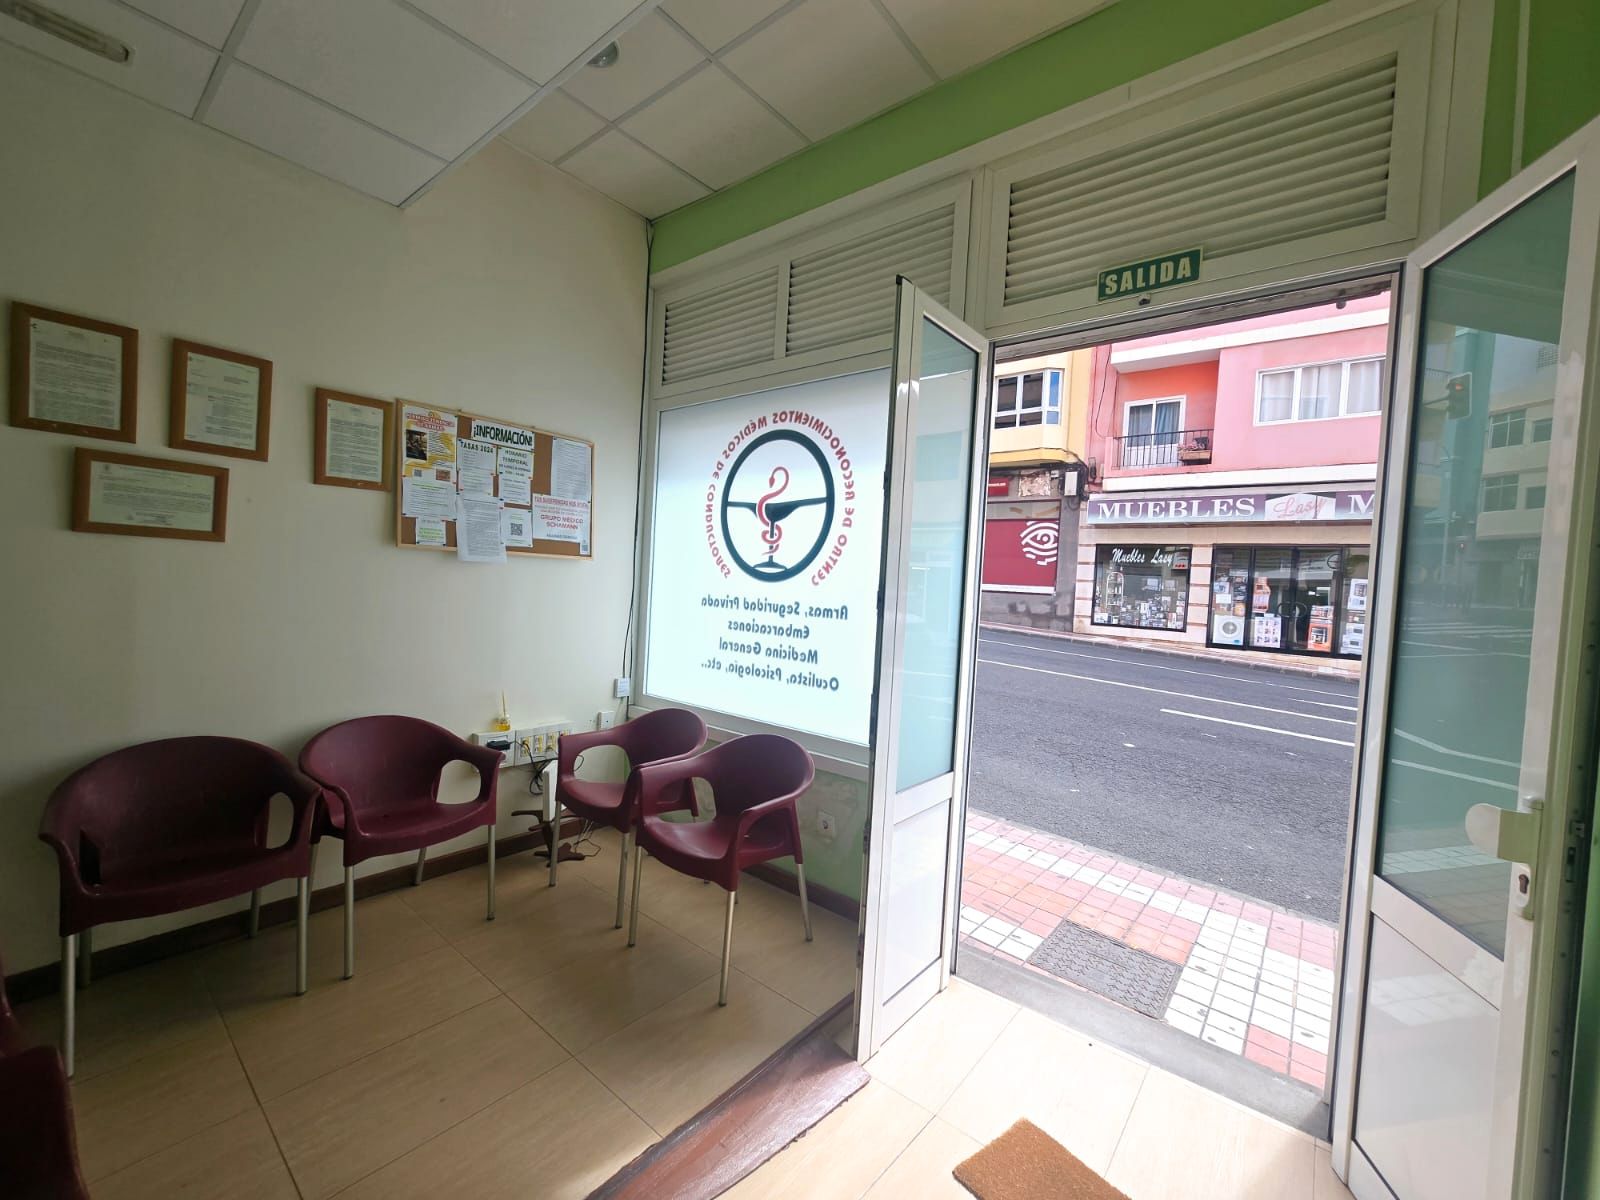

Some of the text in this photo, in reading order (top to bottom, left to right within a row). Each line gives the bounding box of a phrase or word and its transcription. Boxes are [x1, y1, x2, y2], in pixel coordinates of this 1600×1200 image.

[1105, 256, 1192, 295] SALIDA
[473, 424, 533, 446] ¡INFORMACIÓN!
[1097, 496, 1255, 519] MUEBLES
[1111, 547, 1145, 564] Muebles
